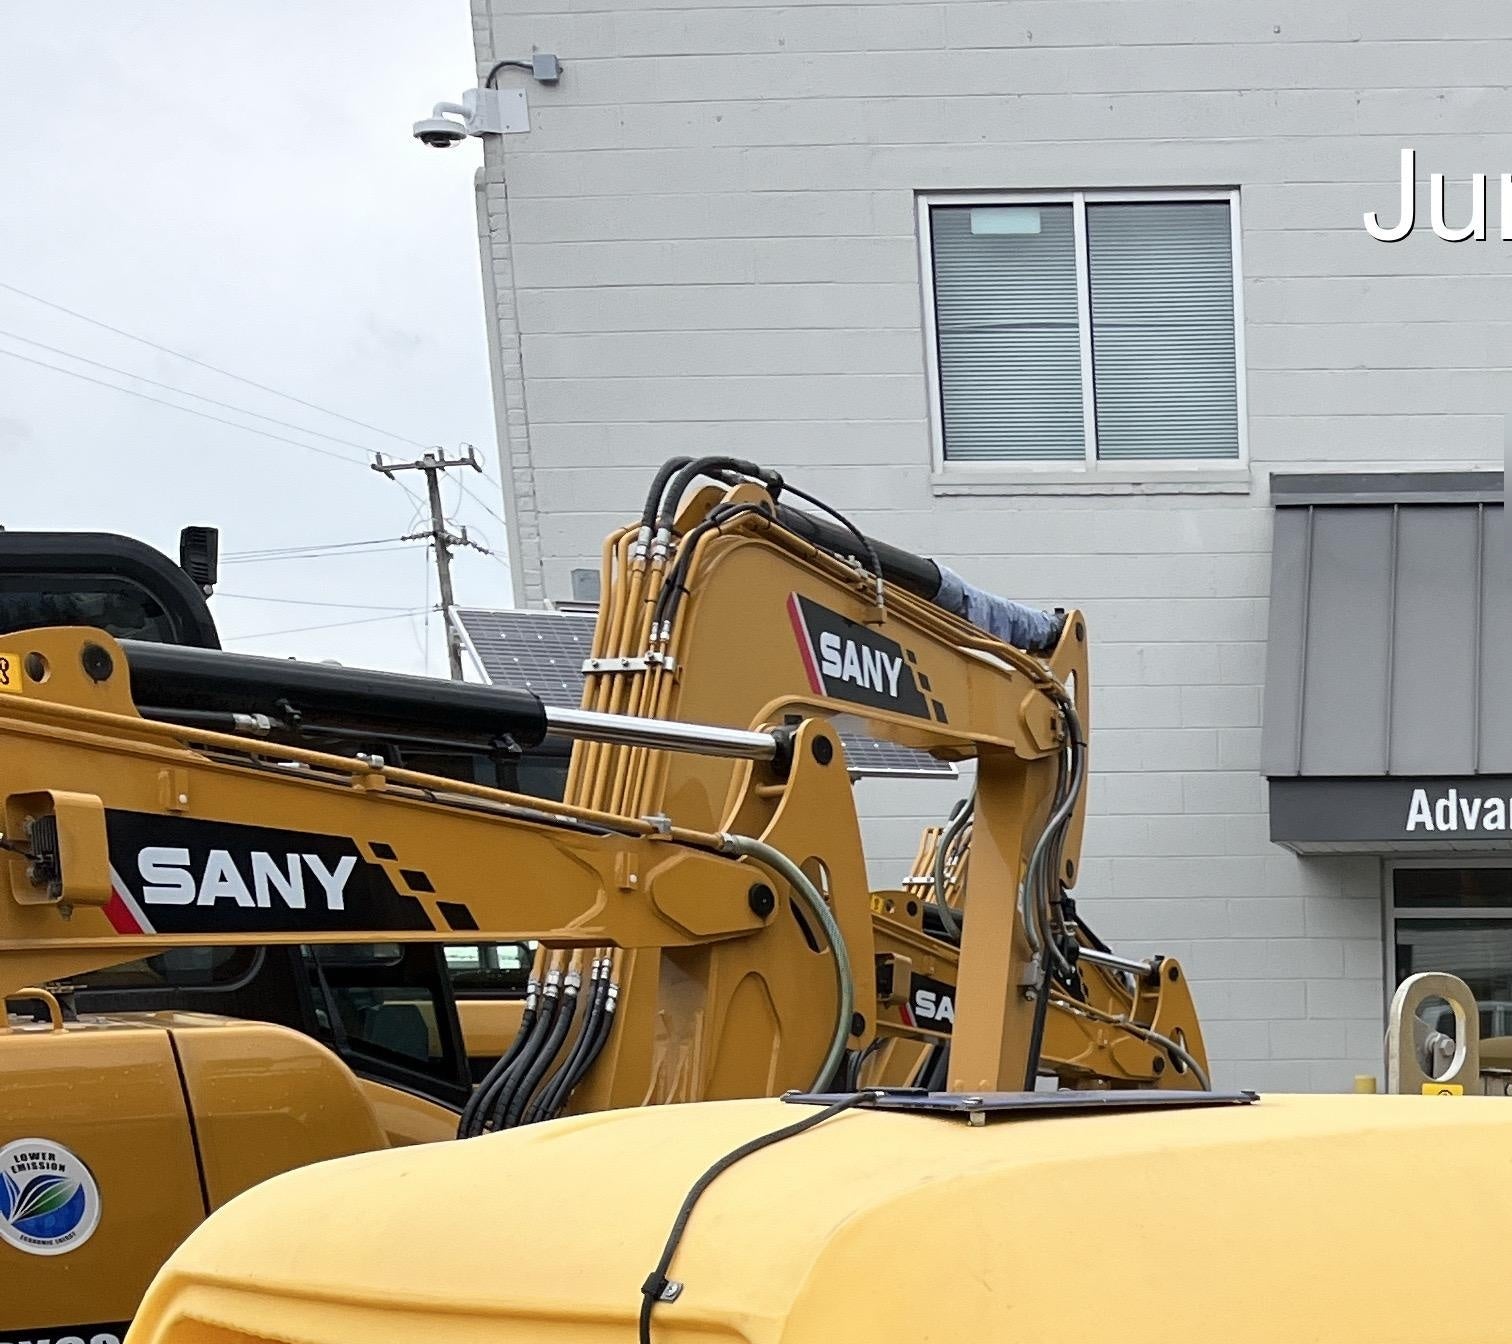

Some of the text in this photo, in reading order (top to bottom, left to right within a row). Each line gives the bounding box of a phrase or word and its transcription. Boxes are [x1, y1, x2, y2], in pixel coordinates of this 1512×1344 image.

[819, 631, 903, 698] SANY
[137, 846, 358, 911] SANY
[915, 989, 955, 1024] SA
[11, 1162, 66, 1174] EMISSION
[13, 1152, 56, 1163] LOWER
